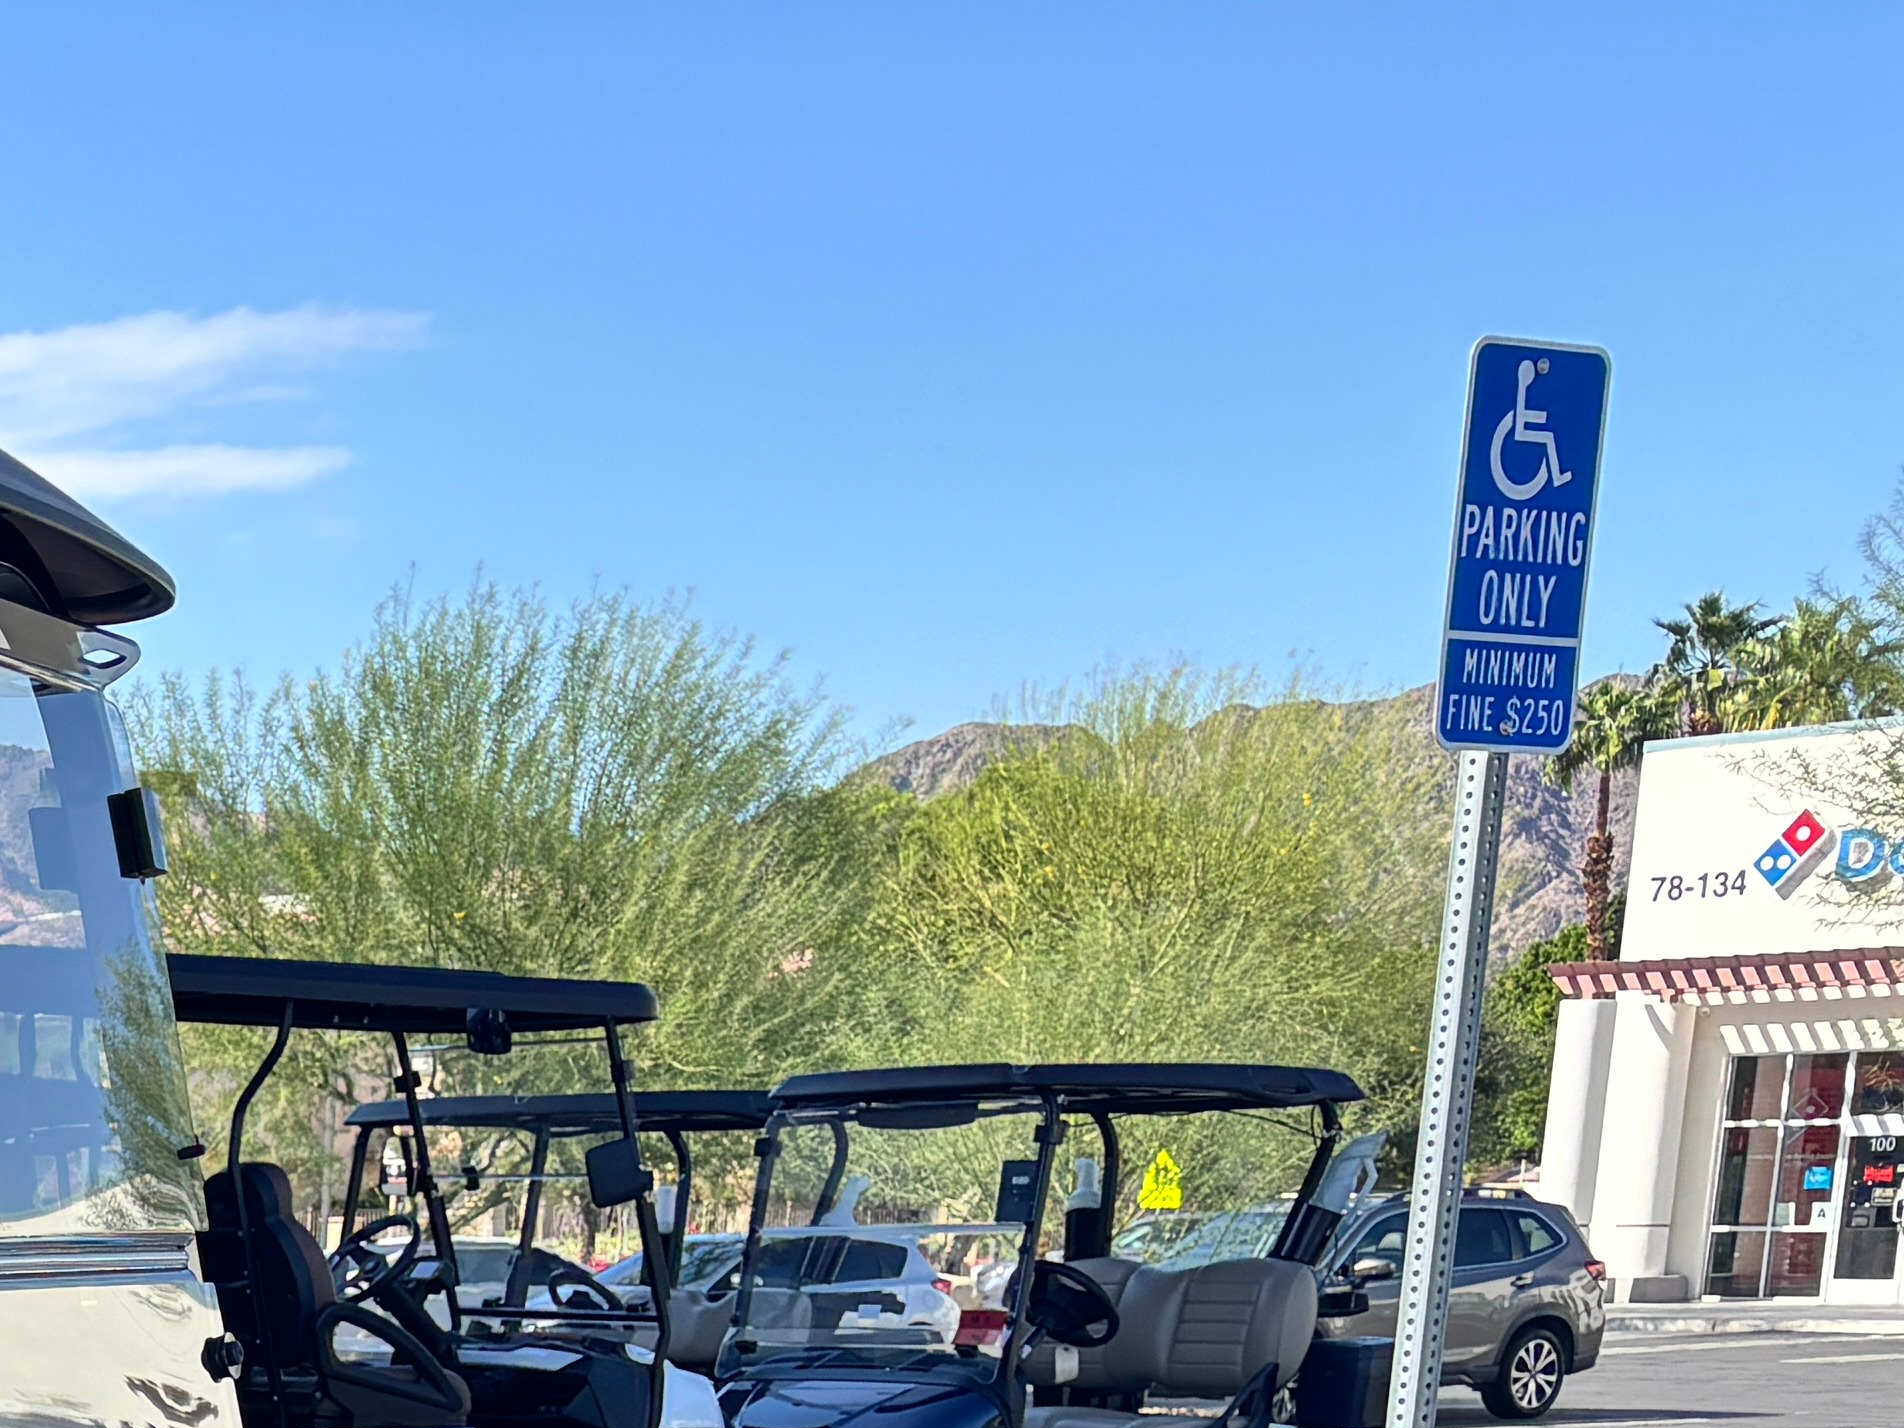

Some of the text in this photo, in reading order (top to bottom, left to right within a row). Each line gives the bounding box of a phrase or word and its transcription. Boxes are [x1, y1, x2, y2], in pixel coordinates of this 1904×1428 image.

[1461, 503, 1587, 567] PARKING
[1479, 569, 1557, 628] ONLY
[1463, 648, 1556, 688] MINIMUM
[1446, 694, 1564, 736] FINE $250
[1650, 869, 1747, 902] 78-134
[1869, 1136, 1897, 1152] 100
[1817, 1208, 1826, 1218] A
